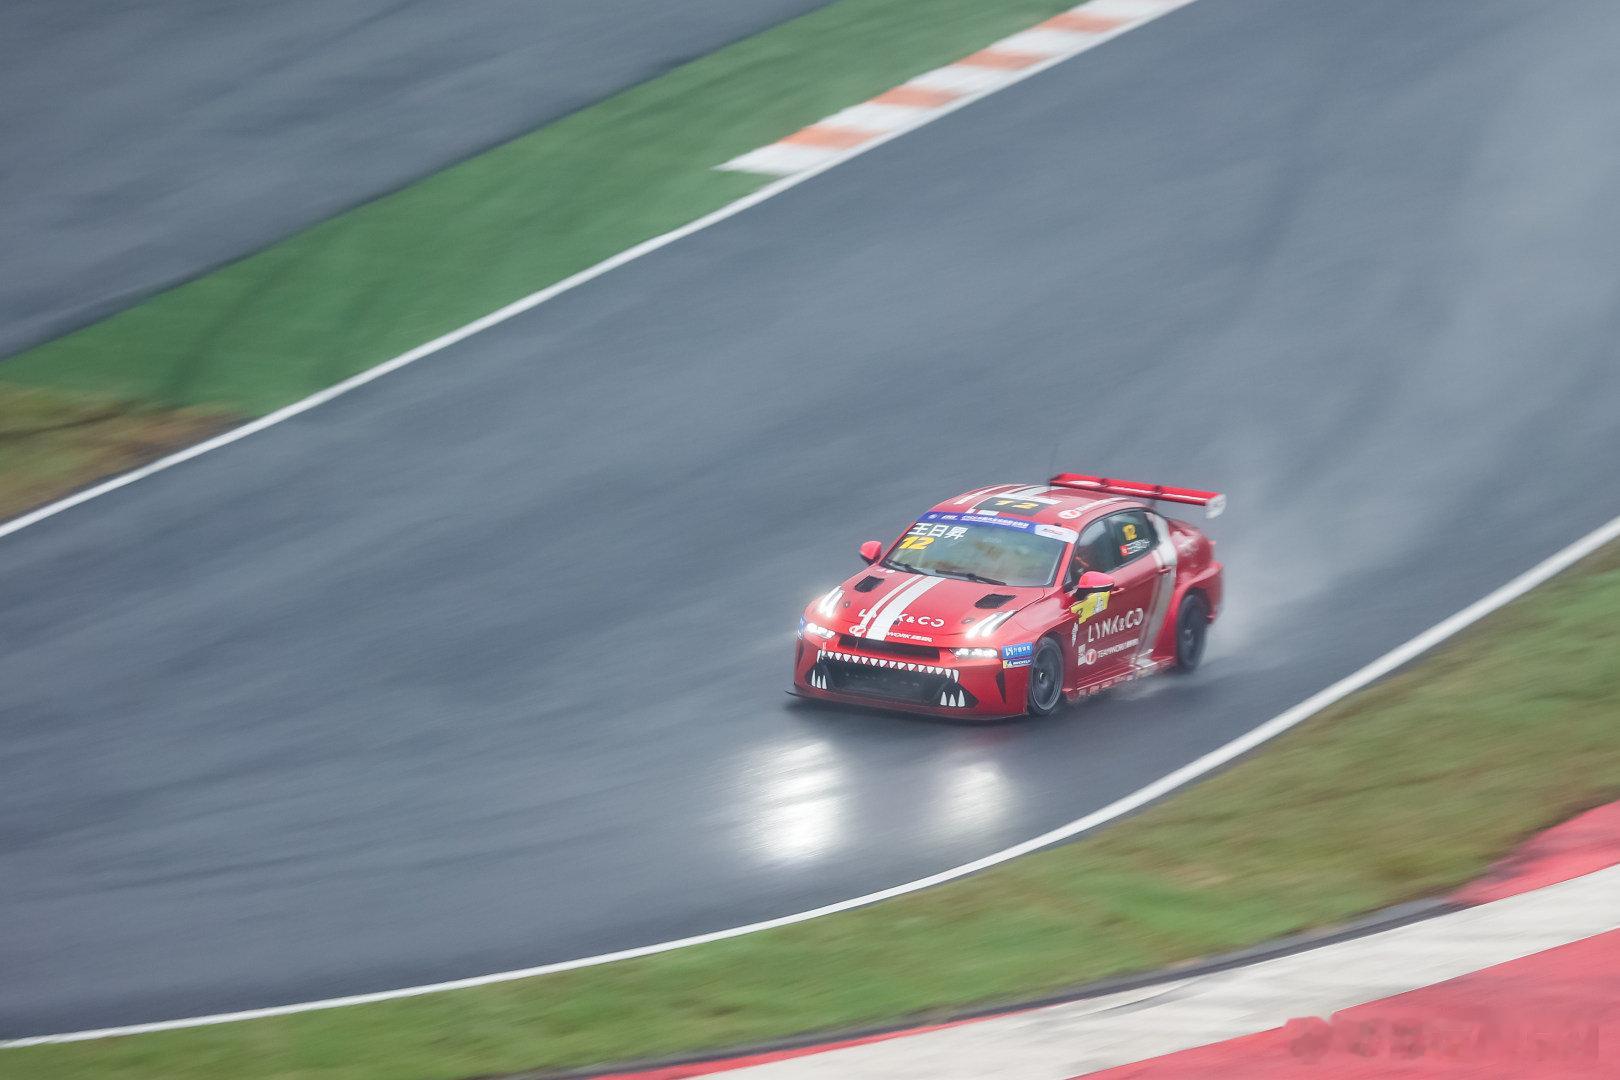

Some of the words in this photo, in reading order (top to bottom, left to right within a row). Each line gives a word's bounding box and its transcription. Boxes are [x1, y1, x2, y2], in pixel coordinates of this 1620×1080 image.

[907, 522, 969, 540] 王日昇
[1122, 523, 1138, 541] 12
[898, 535, 936, 550] 12
